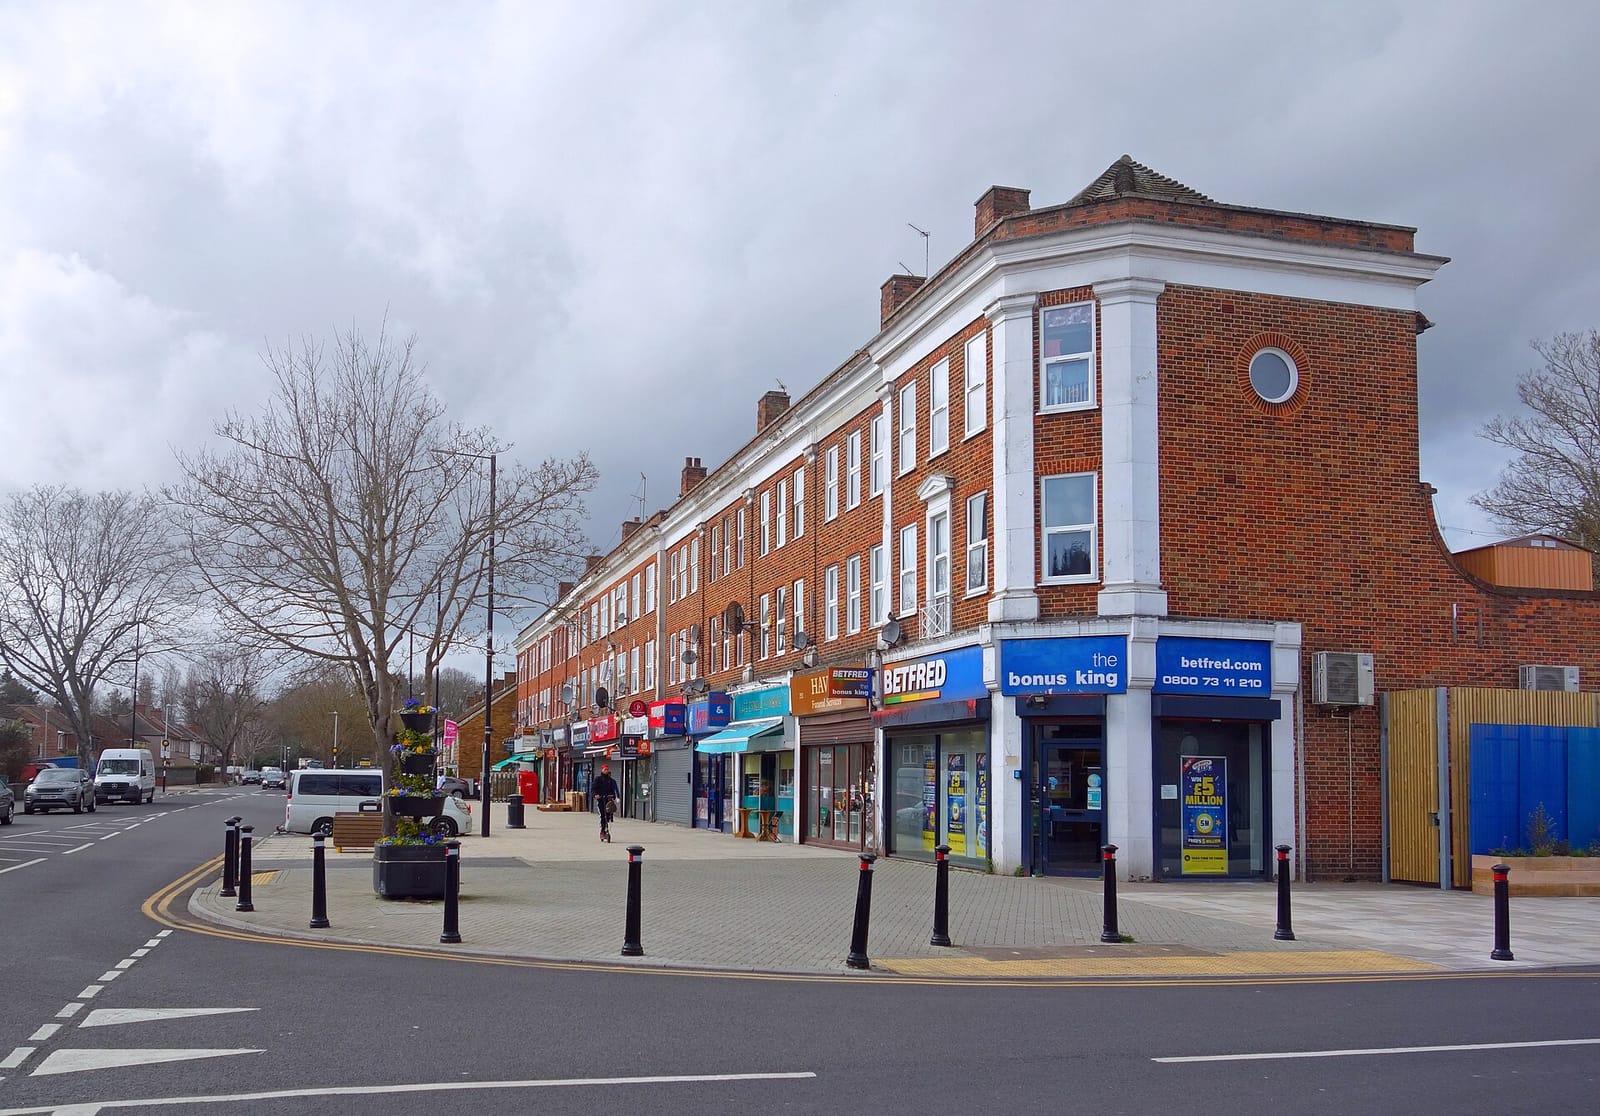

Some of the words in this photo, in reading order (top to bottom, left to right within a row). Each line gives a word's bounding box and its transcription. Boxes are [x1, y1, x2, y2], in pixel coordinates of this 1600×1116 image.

[1093, 653, 1118, 667] the
[1181, 657, 1262, 671] betfred.com
[832, 670, 869, 678] BETFRED
[883, 659, 947, 694] BETFRED
[1009, 672, 1068, 686] bonus
[1076, 670, 1118, 688] king
[1162, 676, 1199, 685] 0800
[1202, 677, 1220, 686] 73
[1223, 678, 1236, 687] 11
[1239, 679, 1262, 688] 210
[1194, 776, 1215, 796] £5
[1185, 795, 1223, 806] MILLION
